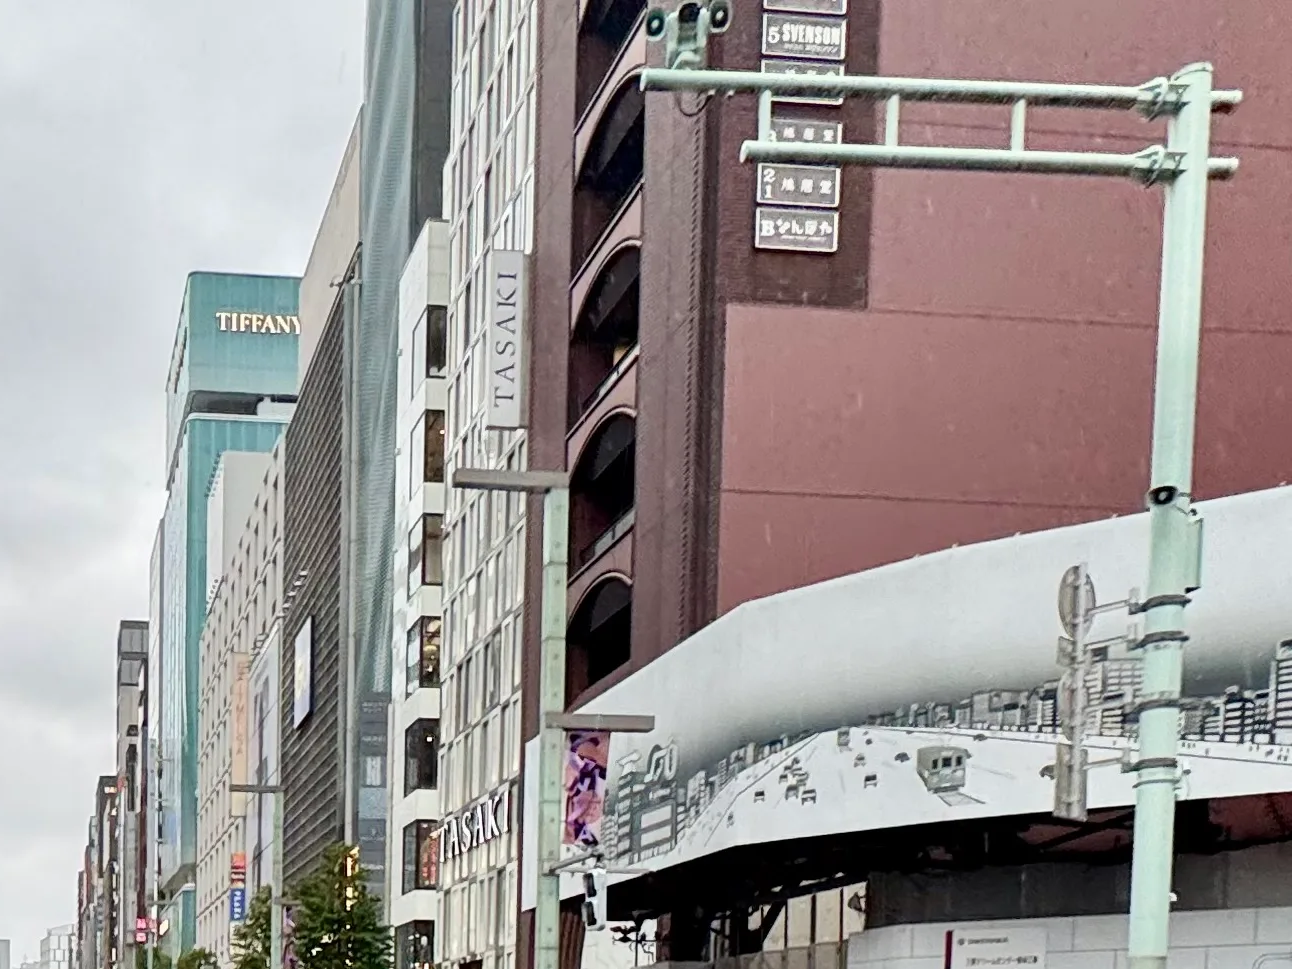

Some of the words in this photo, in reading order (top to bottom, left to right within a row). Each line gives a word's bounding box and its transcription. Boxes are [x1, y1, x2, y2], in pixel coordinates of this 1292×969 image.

[768, 25, 780, 43] 5
[782, 22, 841, 45] SVENSON
[763, 168, 776, 183] 2
[764, 184, 772, 198] 1
[215, 312, 301, 335] TIFFANY
[493, 272, 517, 408] TASAKI
[435, 790, 510, 863] TASAKI
